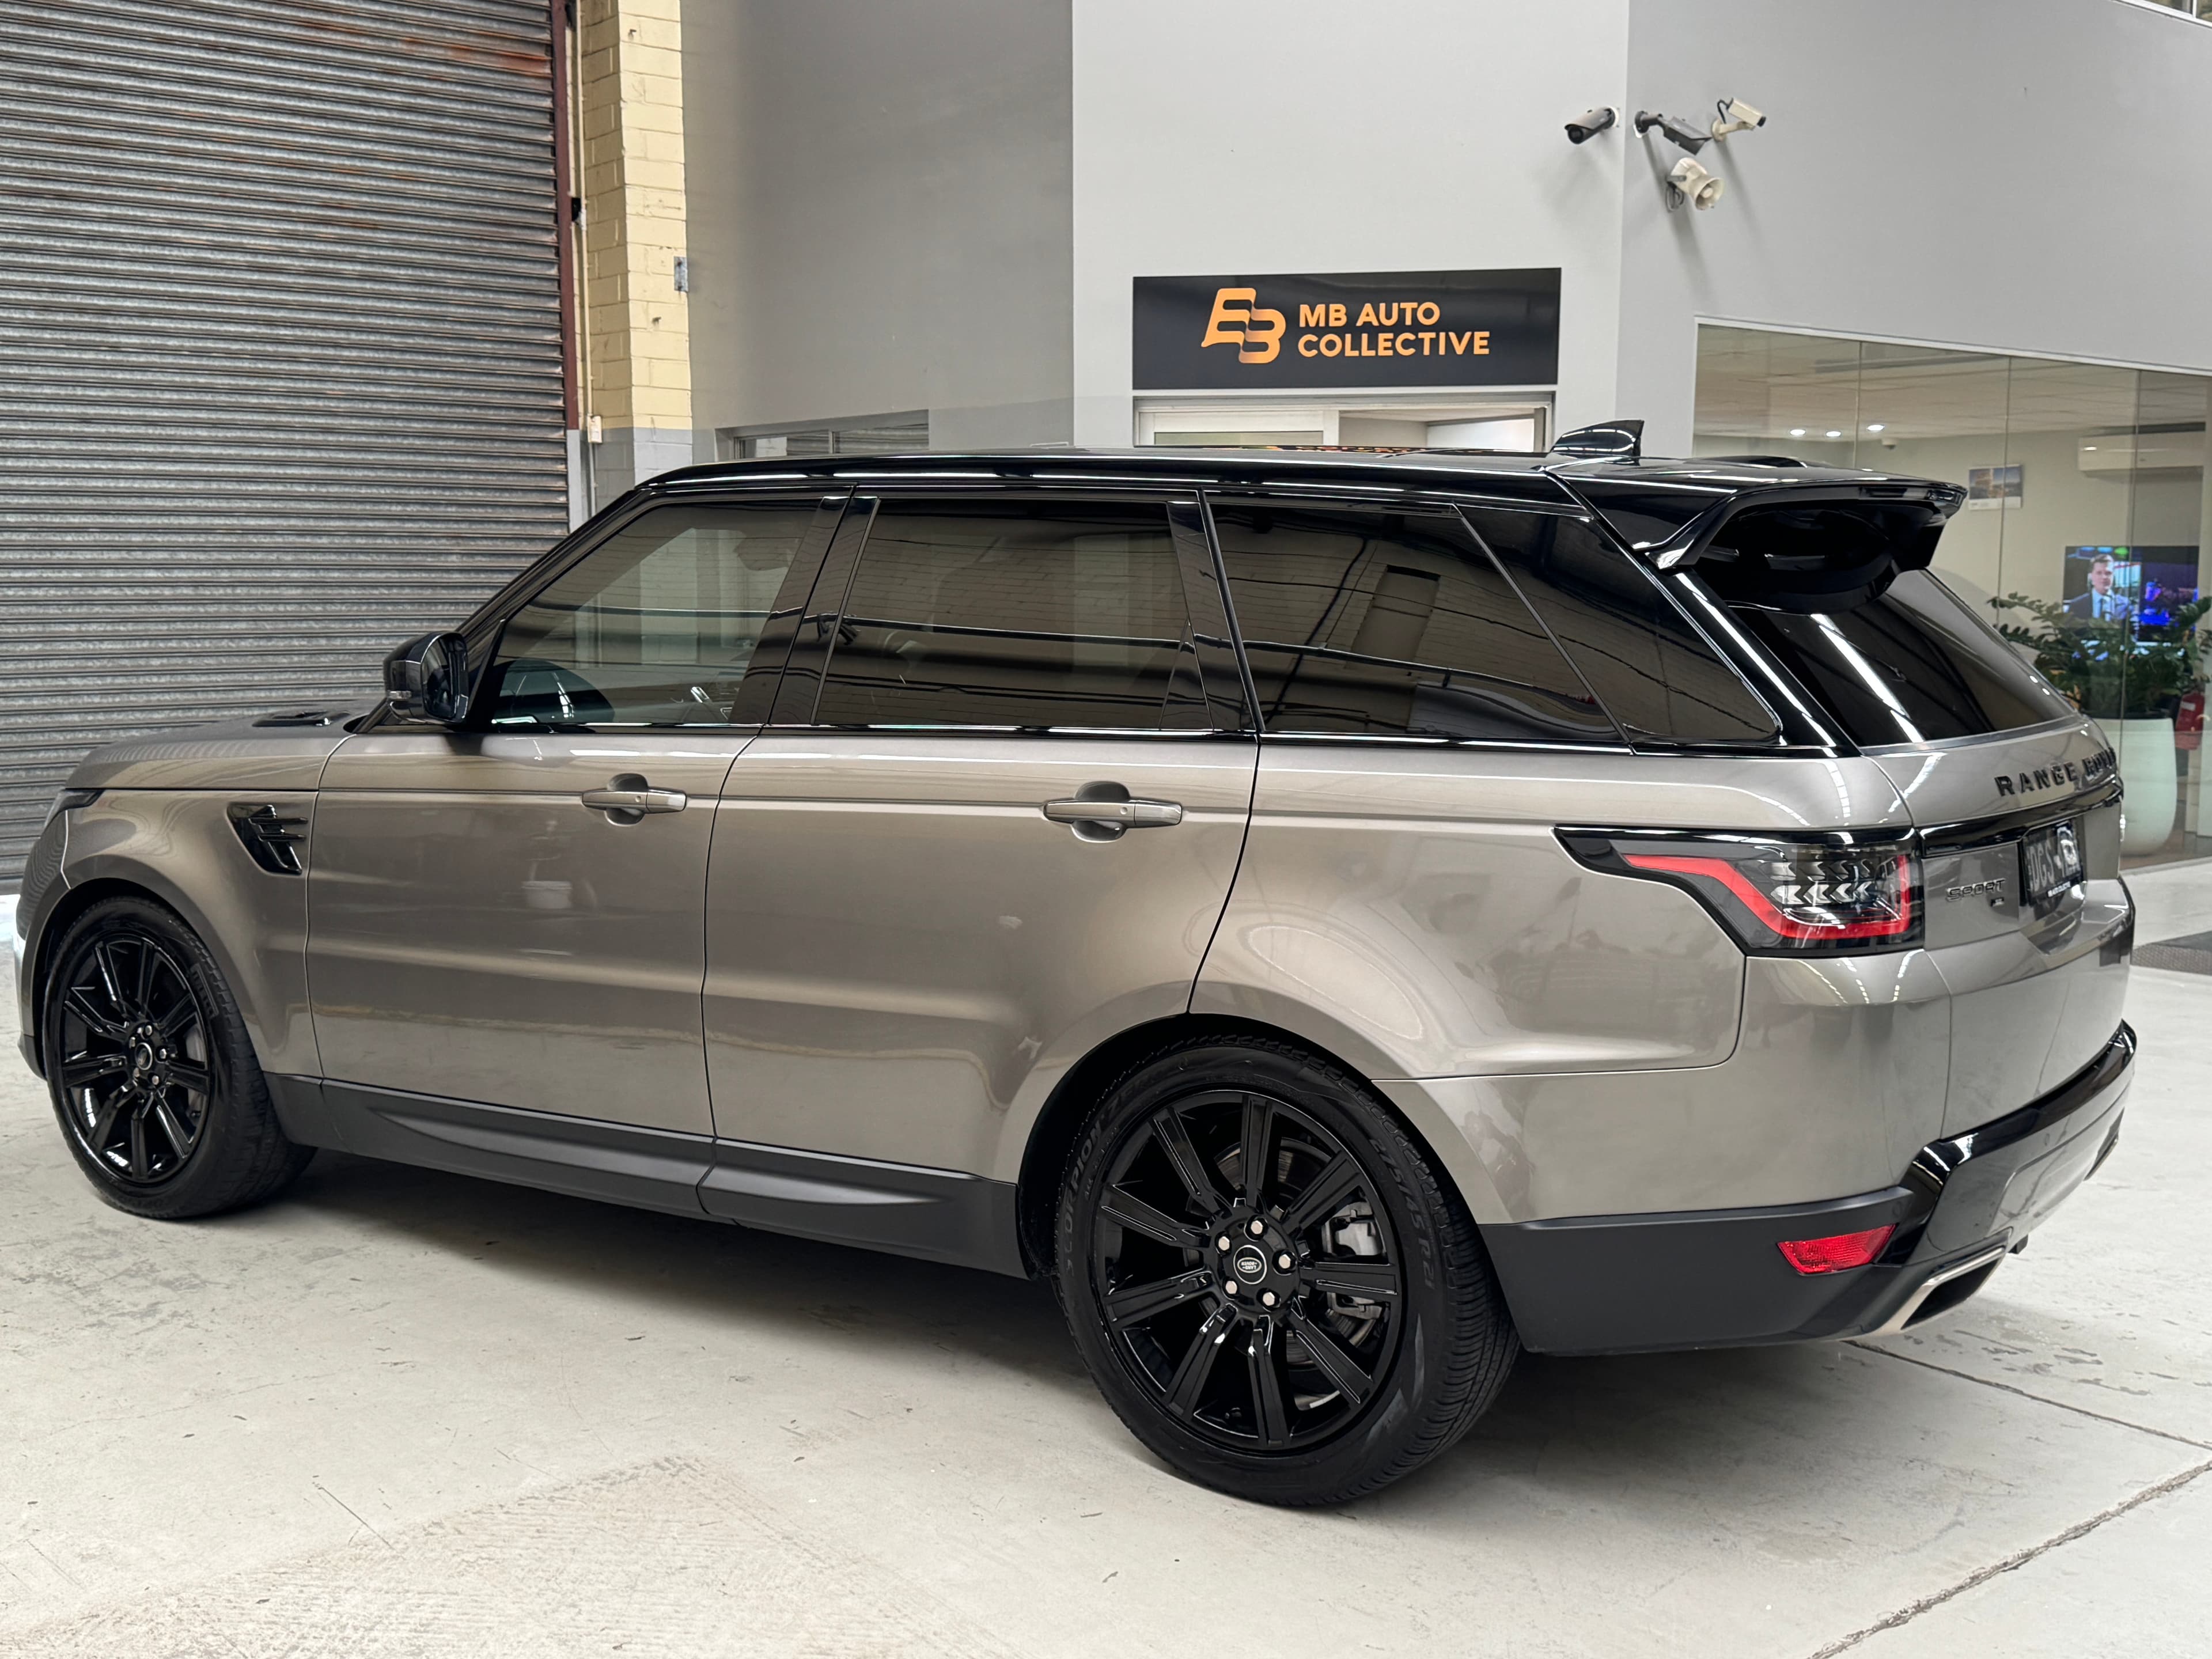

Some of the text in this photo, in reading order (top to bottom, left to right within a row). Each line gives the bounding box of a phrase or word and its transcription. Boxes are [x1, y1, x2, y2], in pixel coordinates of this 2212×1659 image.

[1299, 302, 1440, 327] MB AUTO
[1298, 331, 1490, 357] COLLECTIVE
[1994, 762, 2078, 797] RANGE
[1946, 877, 2006, 902] SPORT
[1064, 1119, 1102, 1277] SCORPION
[1368, 1138, 1425, 1230] 275/45
